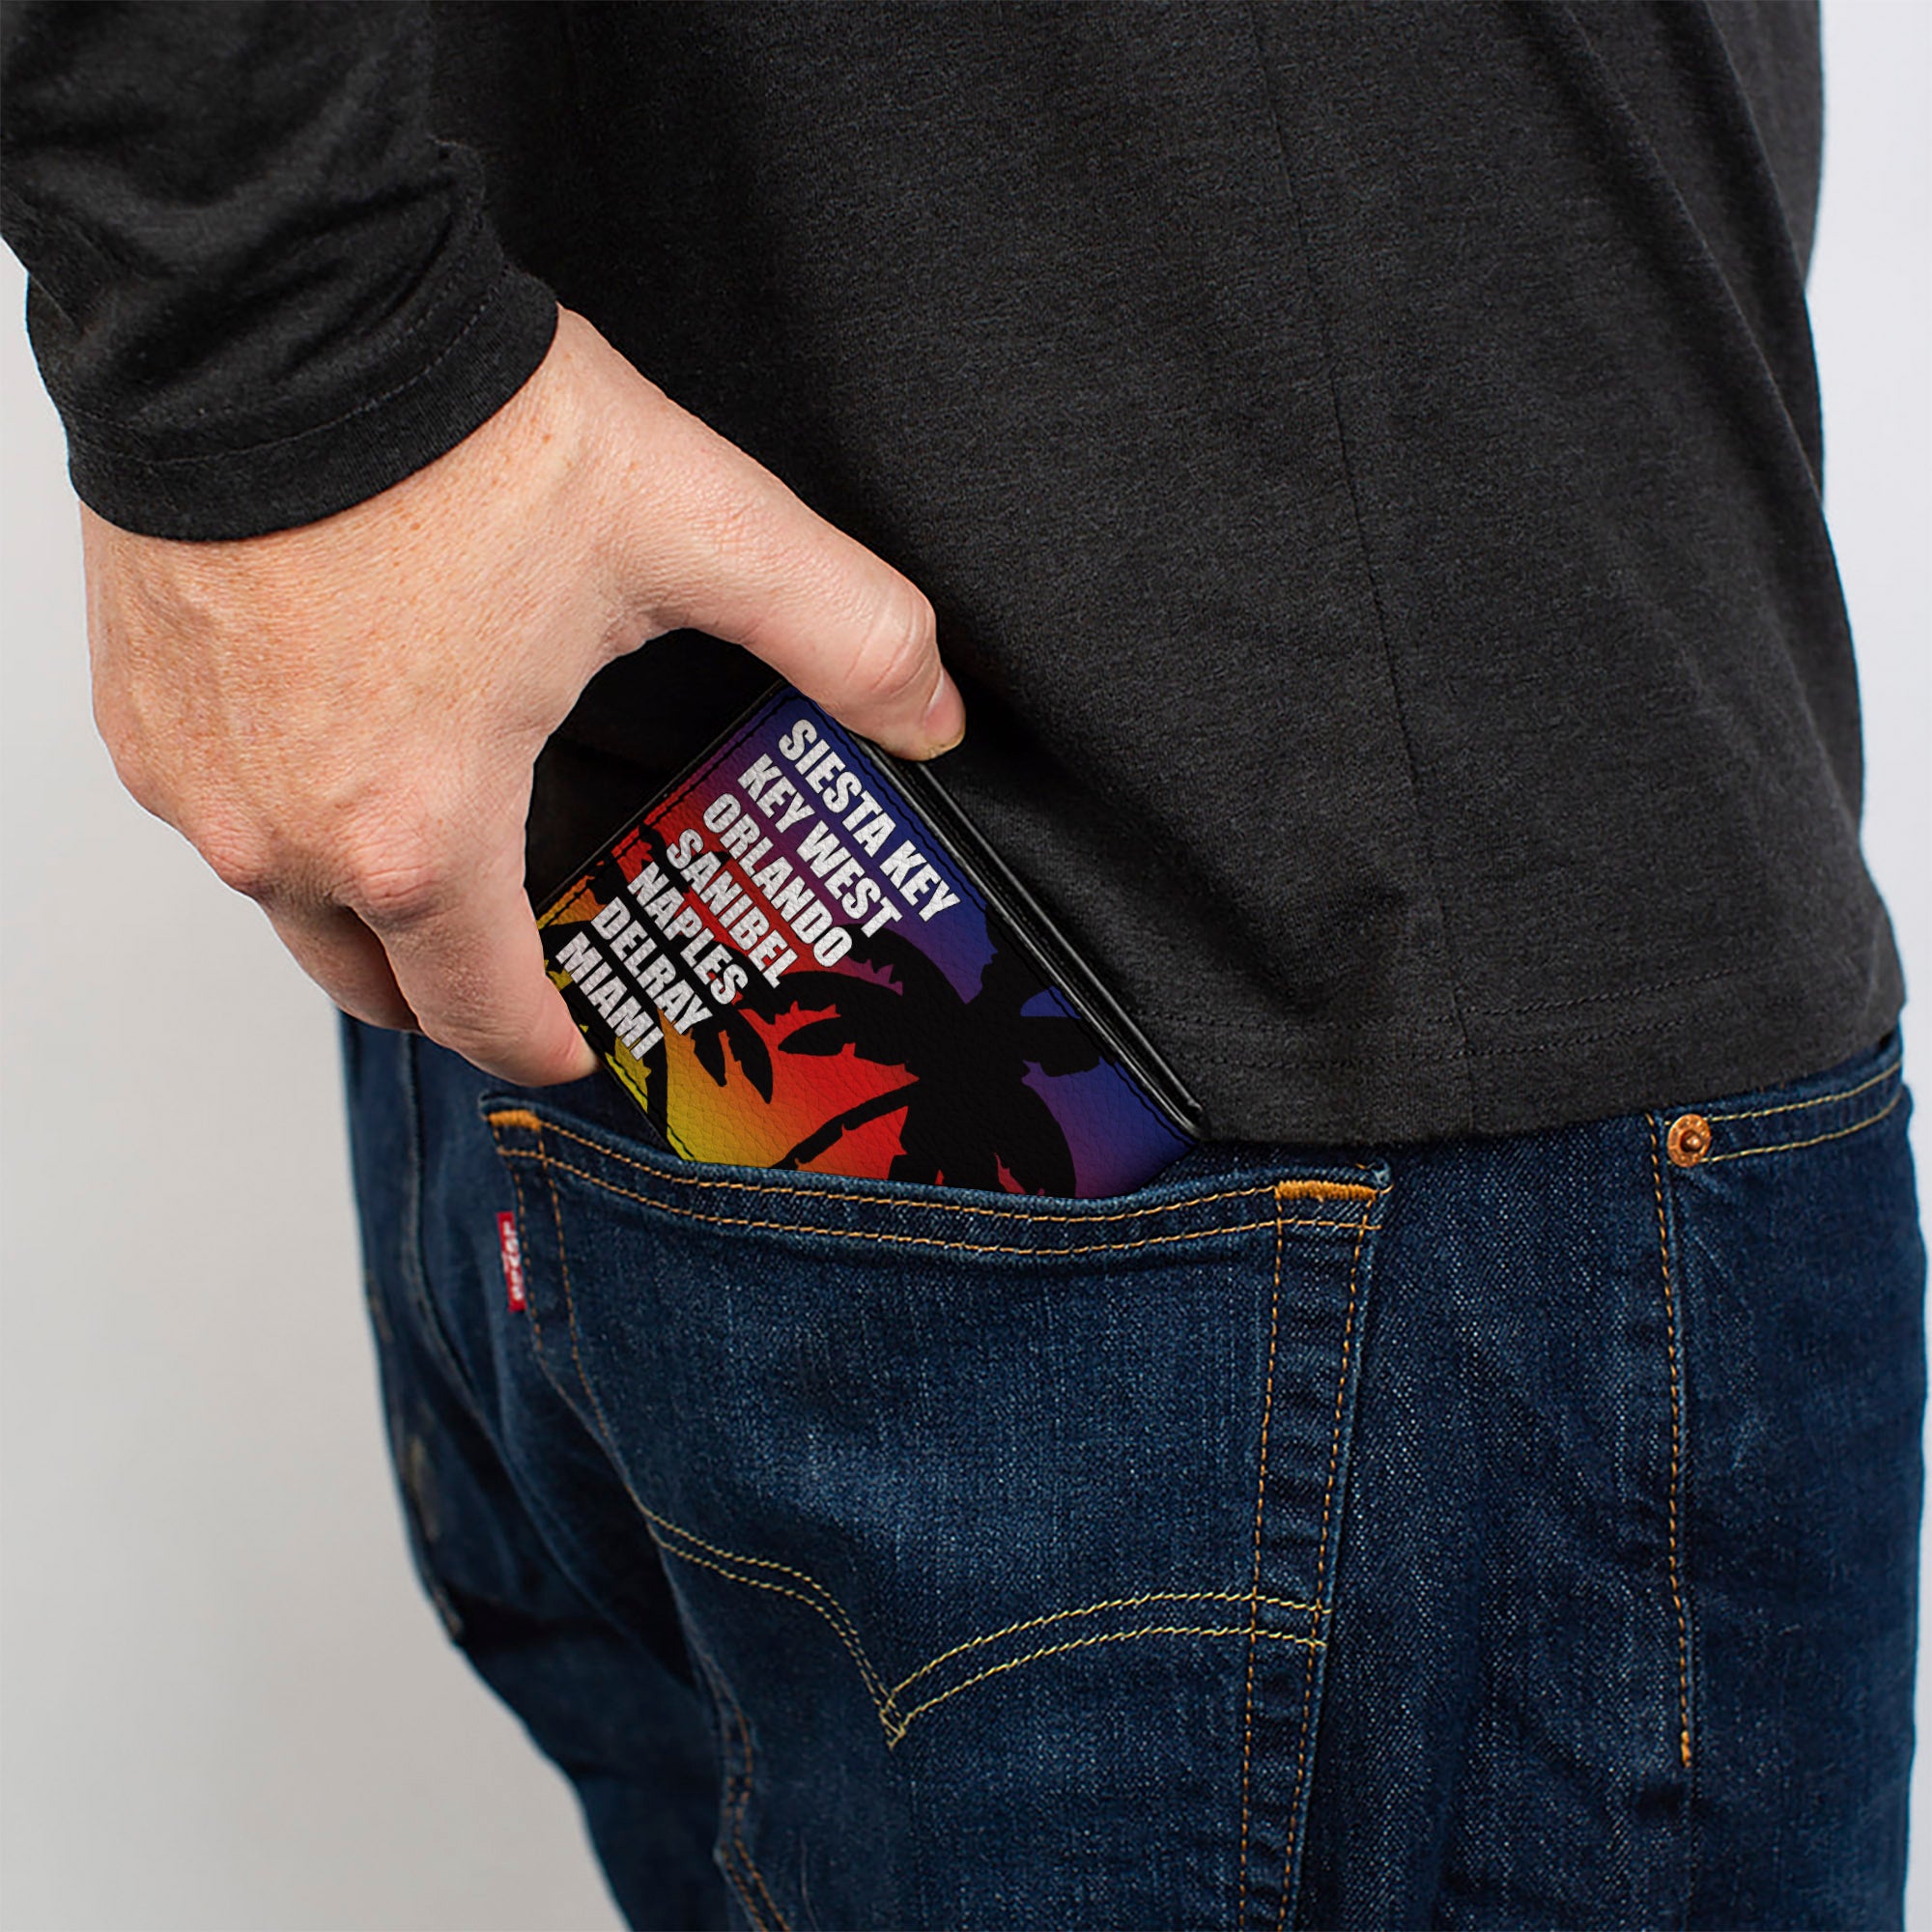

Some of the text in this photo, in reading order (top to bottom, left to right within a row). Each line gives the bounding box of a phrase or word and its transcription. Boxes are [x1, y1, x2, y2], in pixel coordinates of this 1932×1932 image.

[702, 793, 853, 967] ORLANDO
[737, 753, 903, 938] KEY WEST
[779, 719, 961, 923] SIESTA KEY
[590, 896, 713, 1035] DELRAY
[627, 861, 749, 1005] NAPLES
[666, 828, 798, 988] SANIBEL
[555, 931, 665, 1061] MIAMI
